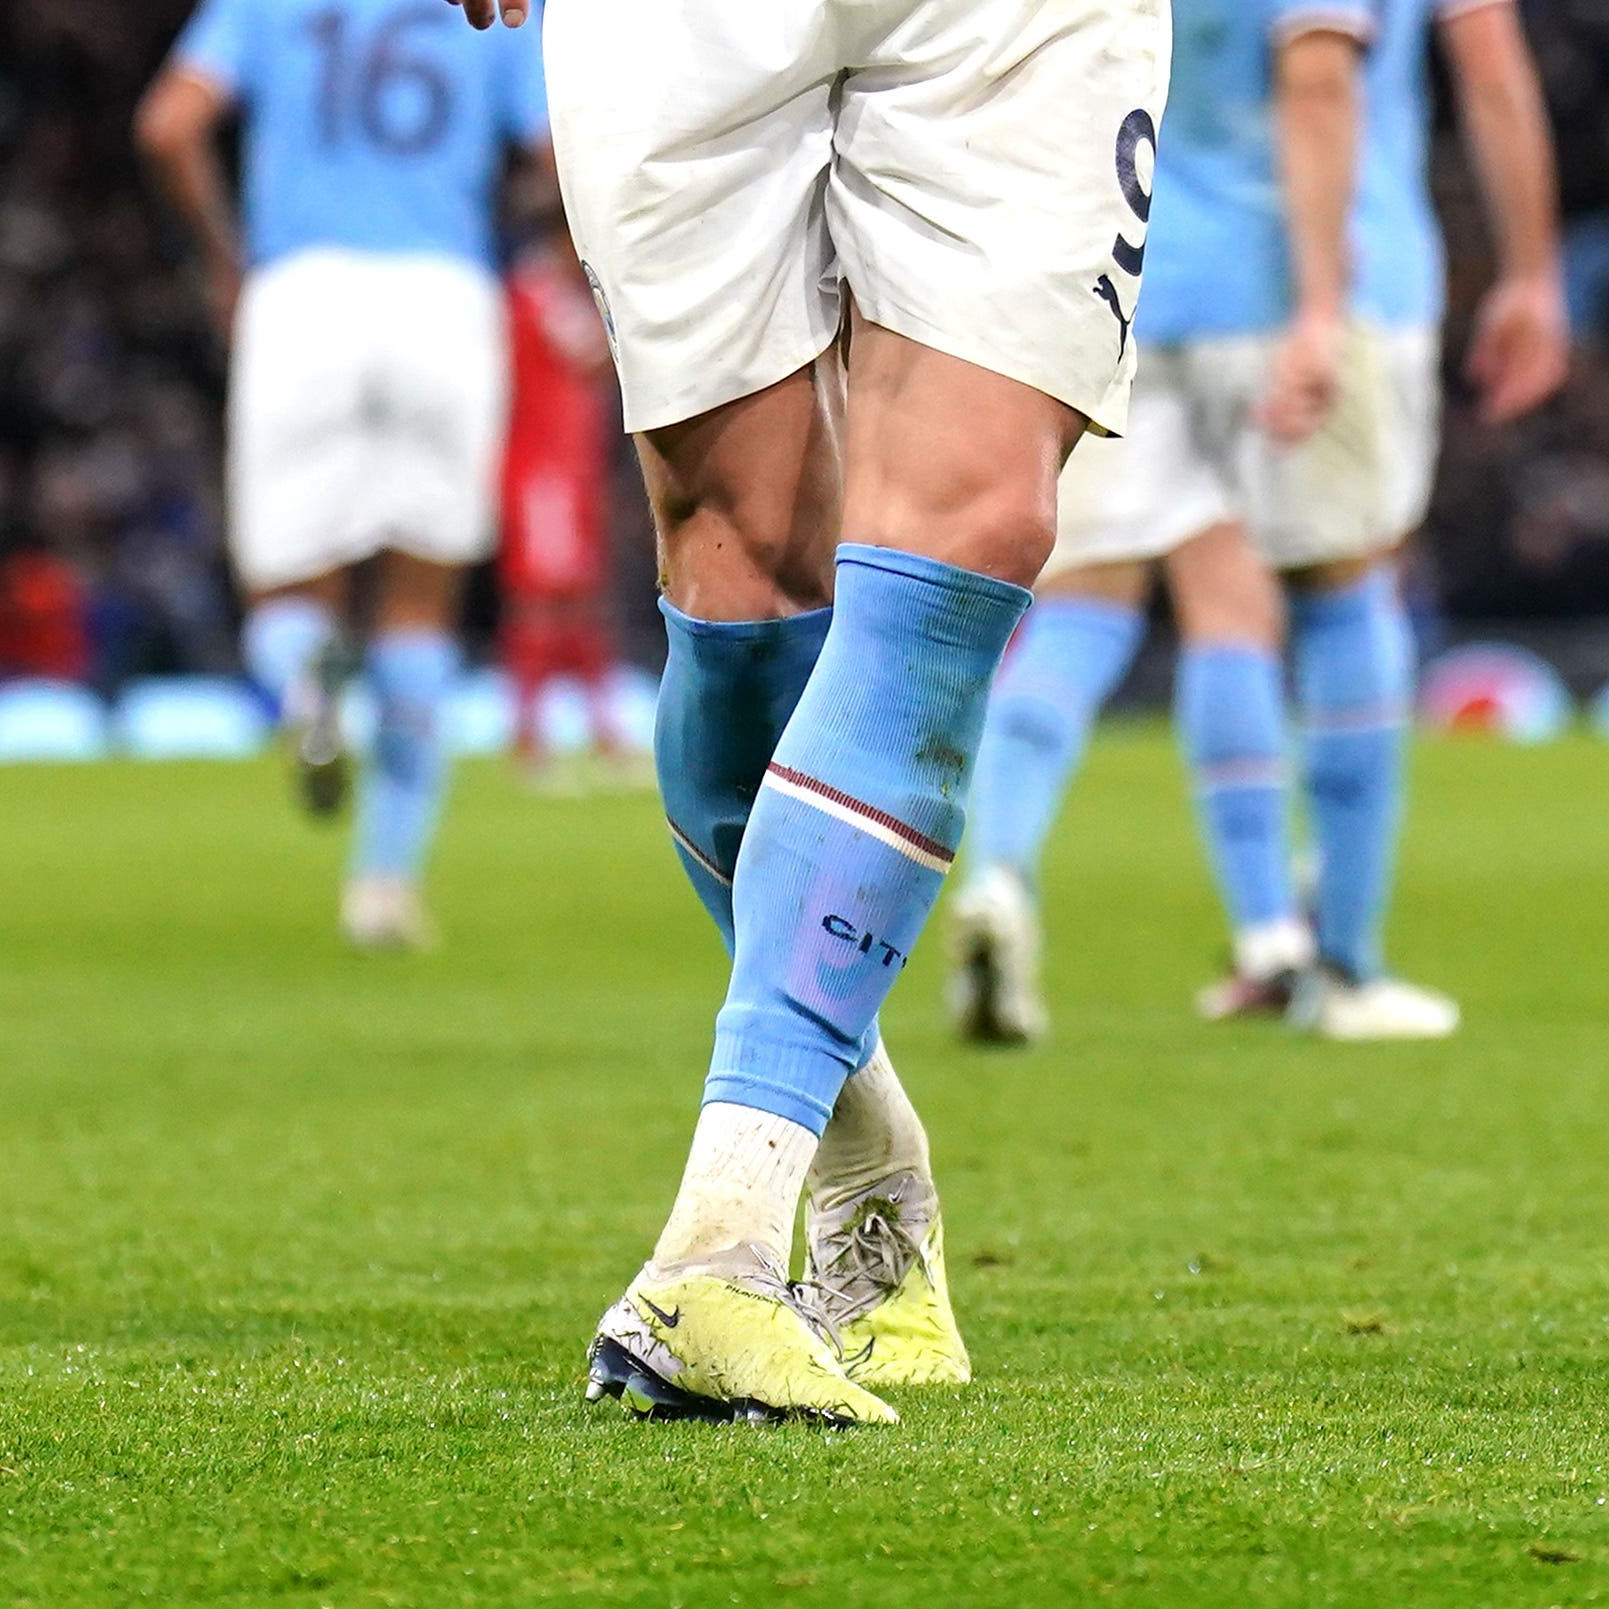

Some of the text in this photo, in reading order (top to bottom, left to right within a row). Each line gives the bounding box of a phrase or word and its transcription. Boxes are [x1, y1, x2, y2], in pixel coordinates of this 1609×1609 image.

[302, 1, 460, 158] 16
[1111, 108, 1157, 277] 9
[822, 914, 907, 968] CIT
